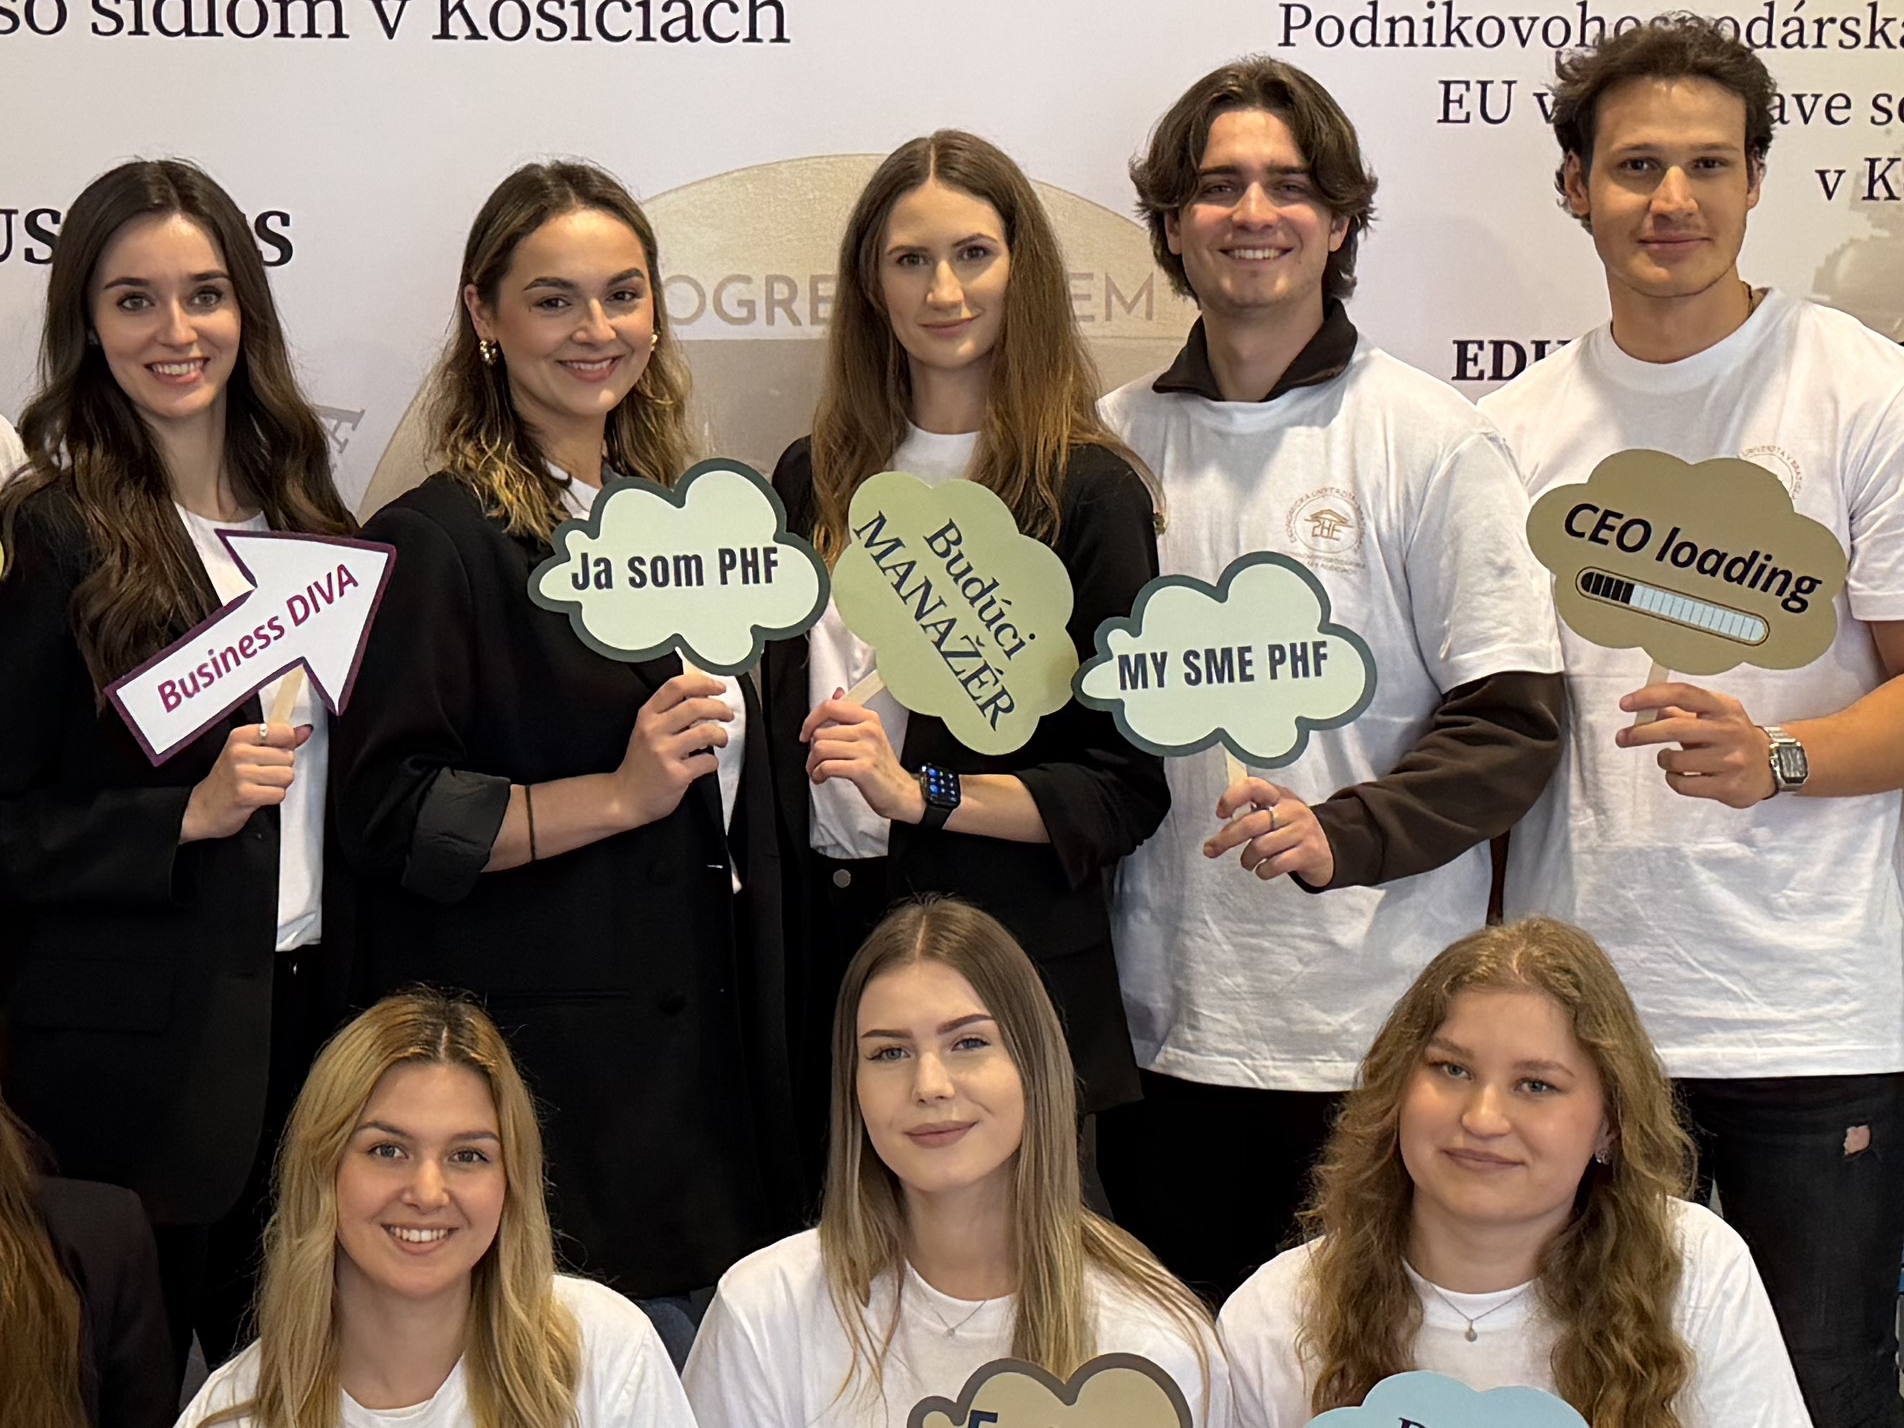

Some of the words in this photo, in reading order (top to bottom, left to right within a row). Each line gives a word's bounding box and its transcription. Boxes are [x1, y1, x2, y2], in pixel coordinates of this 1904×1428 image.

[1436, 79, 1517, 126] EU
[1815, 169, 1850, 203] v
[570, 552, 614, 591] Ja
[628, 551, 704, 589] som
[718, 546, 780, 586] PHF
[923, 517, 1037, 662] Budúci
[1564, 502, 1653, 554] CEO
[1655, 526, 1823, 614] loading
[157, 615, 285, 714] Business
[285, 563, 360, 628] DIVA
[853, 510, 1017, 732] MANAŽÉR
[1117, 651, 1169, 691] MY
[1182, 645, 1256, 687] SME
[1266, 640, 1329, 681] PHF
